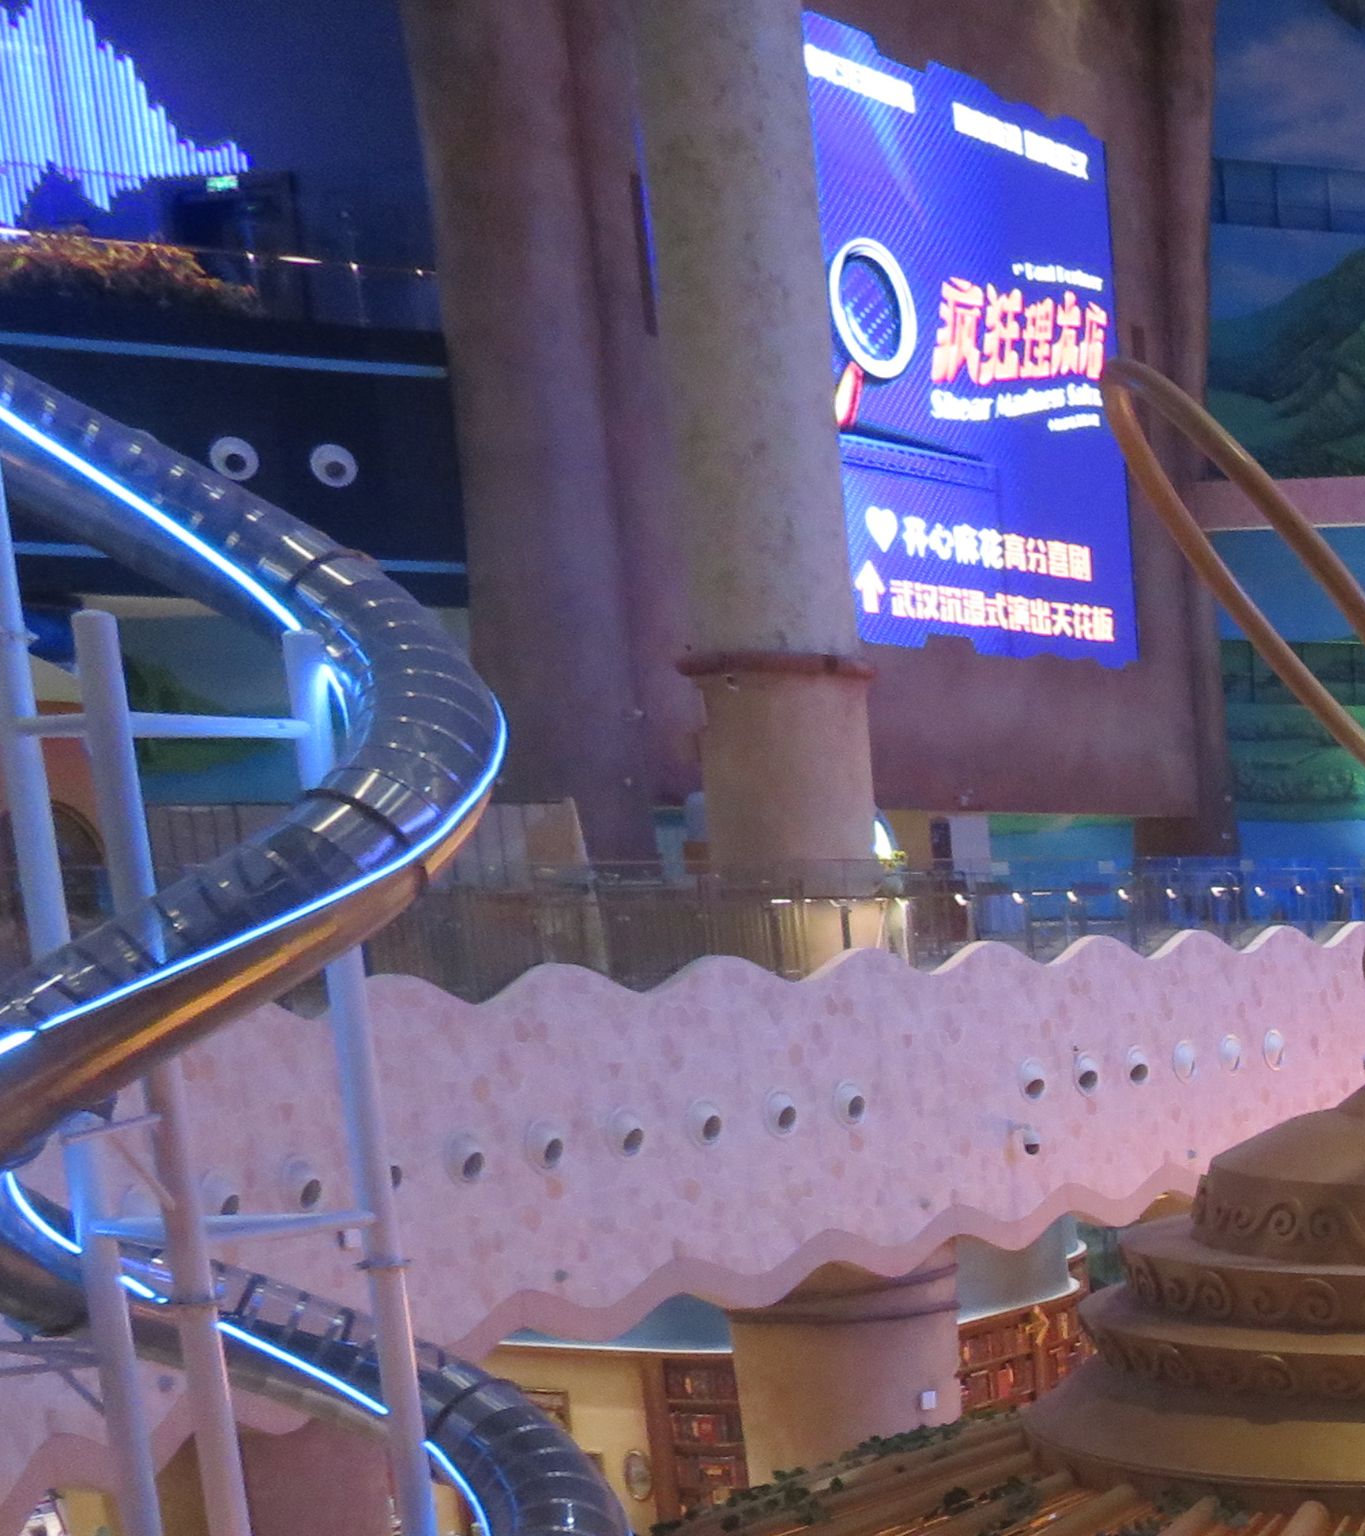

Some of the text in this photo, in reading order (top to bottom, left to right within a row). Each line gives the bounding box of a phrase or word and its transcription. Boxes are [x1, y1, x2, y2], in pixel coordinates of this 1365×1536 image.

[902, 515, 1092, 582] 开心麻花高分喜剧
[889, 578, 1115, 643] 武汉沉浸式演出天花板
